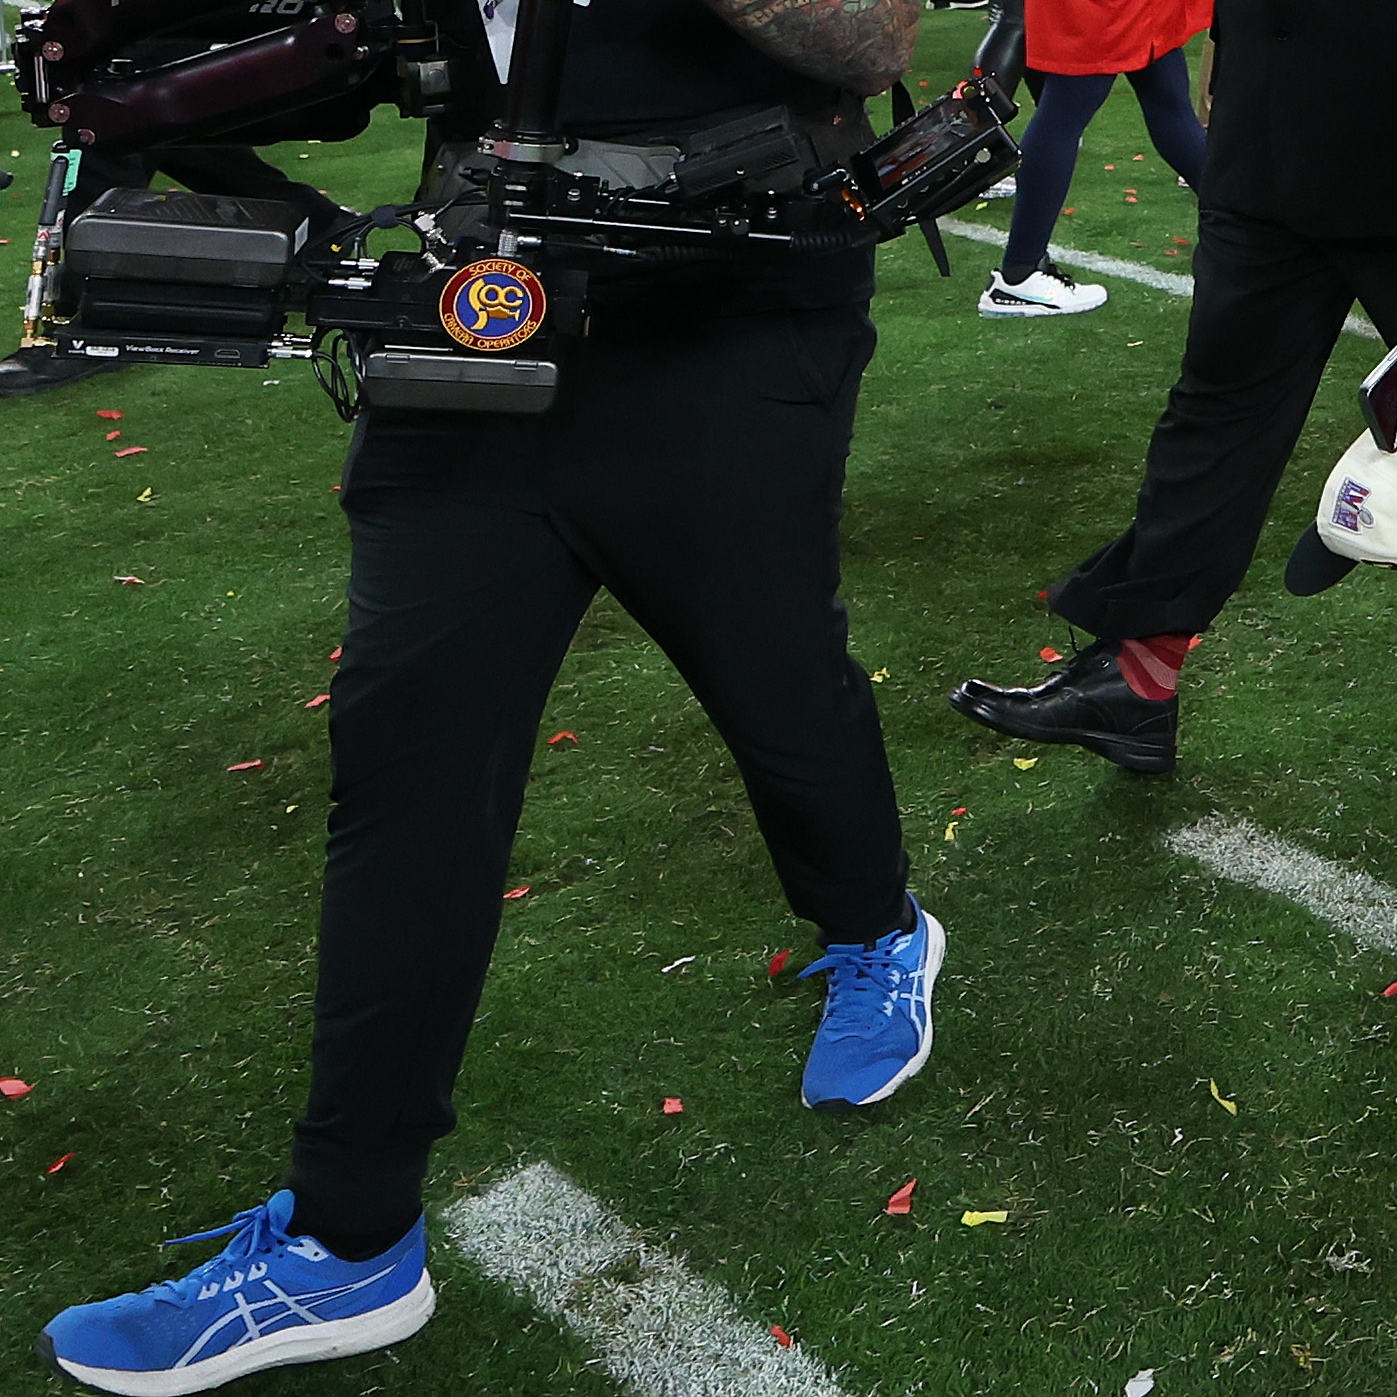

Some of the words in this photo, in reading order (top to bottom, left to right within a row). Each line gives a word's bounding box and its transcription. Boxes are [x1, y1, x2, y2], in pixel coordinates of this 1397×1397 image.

[469, 262, 515, 276] SOCIETY
[516, 270, 531, 281] OF
[444, 312, 475, 346] CAMERA
[477, 320, 537, 349] OPERATORS
